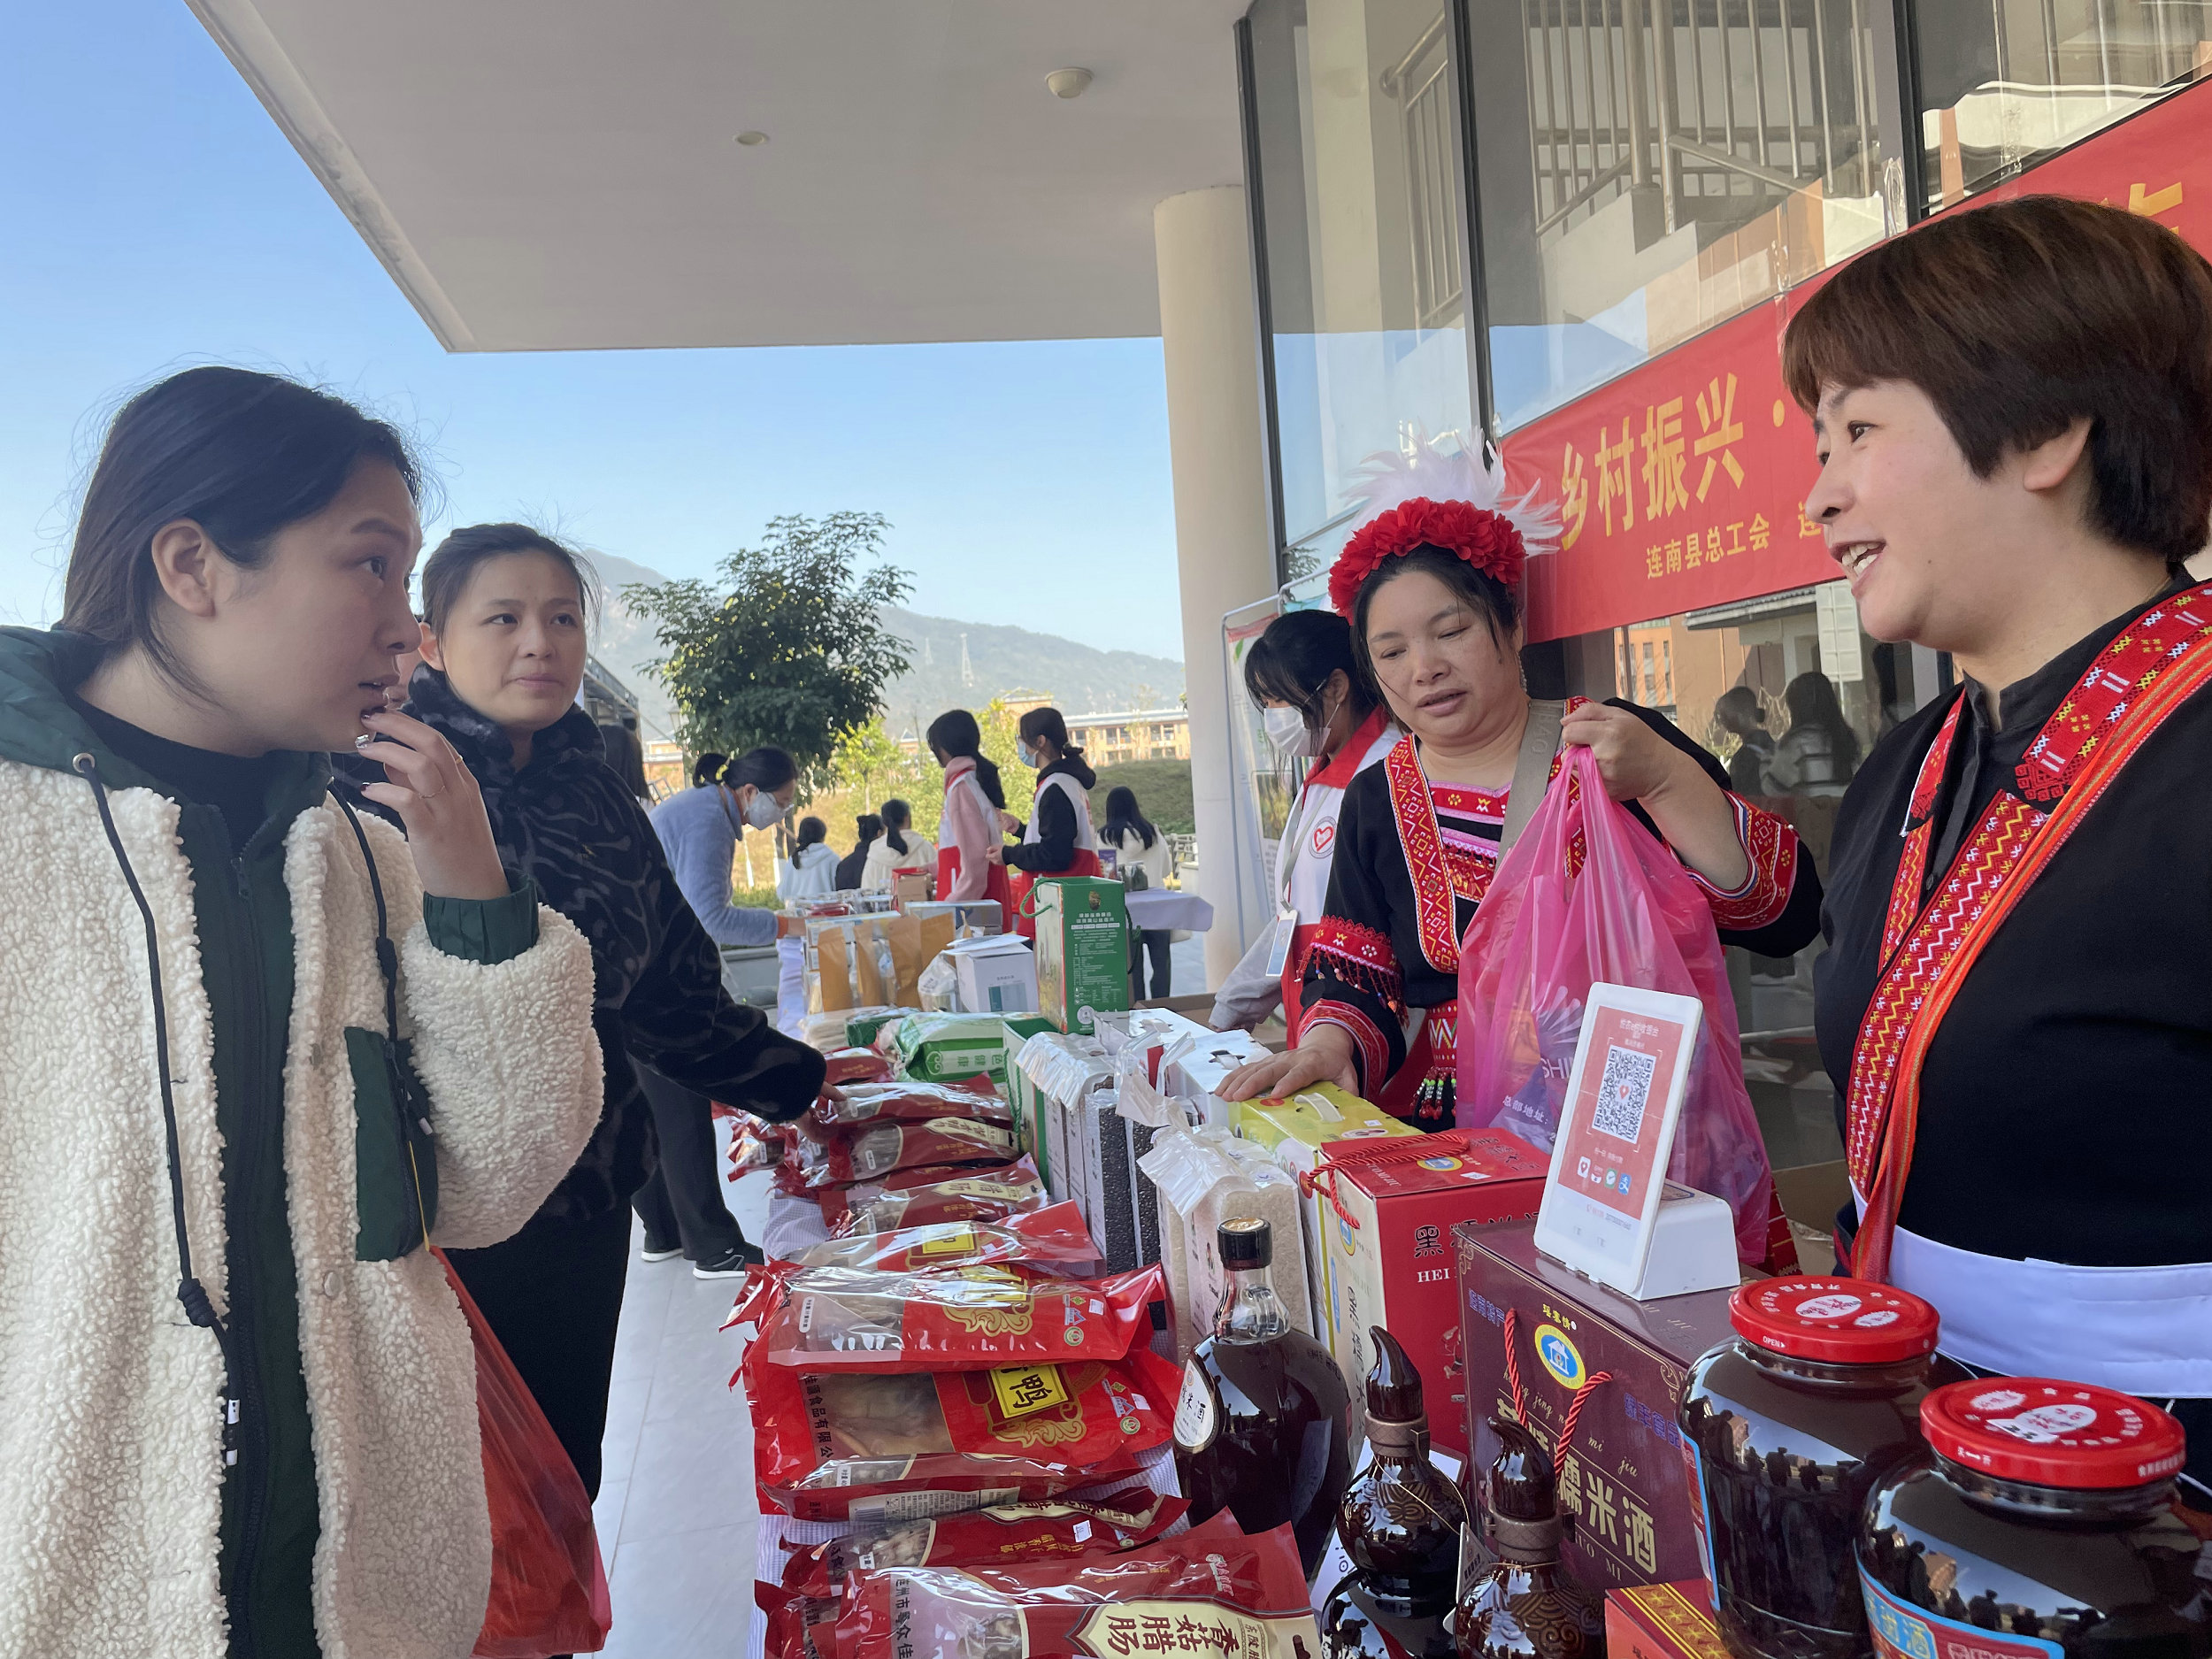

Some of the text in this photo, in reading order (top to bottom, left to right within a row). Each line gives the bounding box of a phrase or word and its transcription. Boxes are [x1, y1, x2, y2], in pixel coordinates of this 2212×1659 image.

[1646, 512, 1770, 580] 连南县总工会
[1417, 1268, 1450, 1283] HEI
[1763, 1335, 1780, 1348] OPEN
[1000, 1365, 1053, 1409] 鸭
[1106, 1614, 1240, 1657] 香菇腊肠
